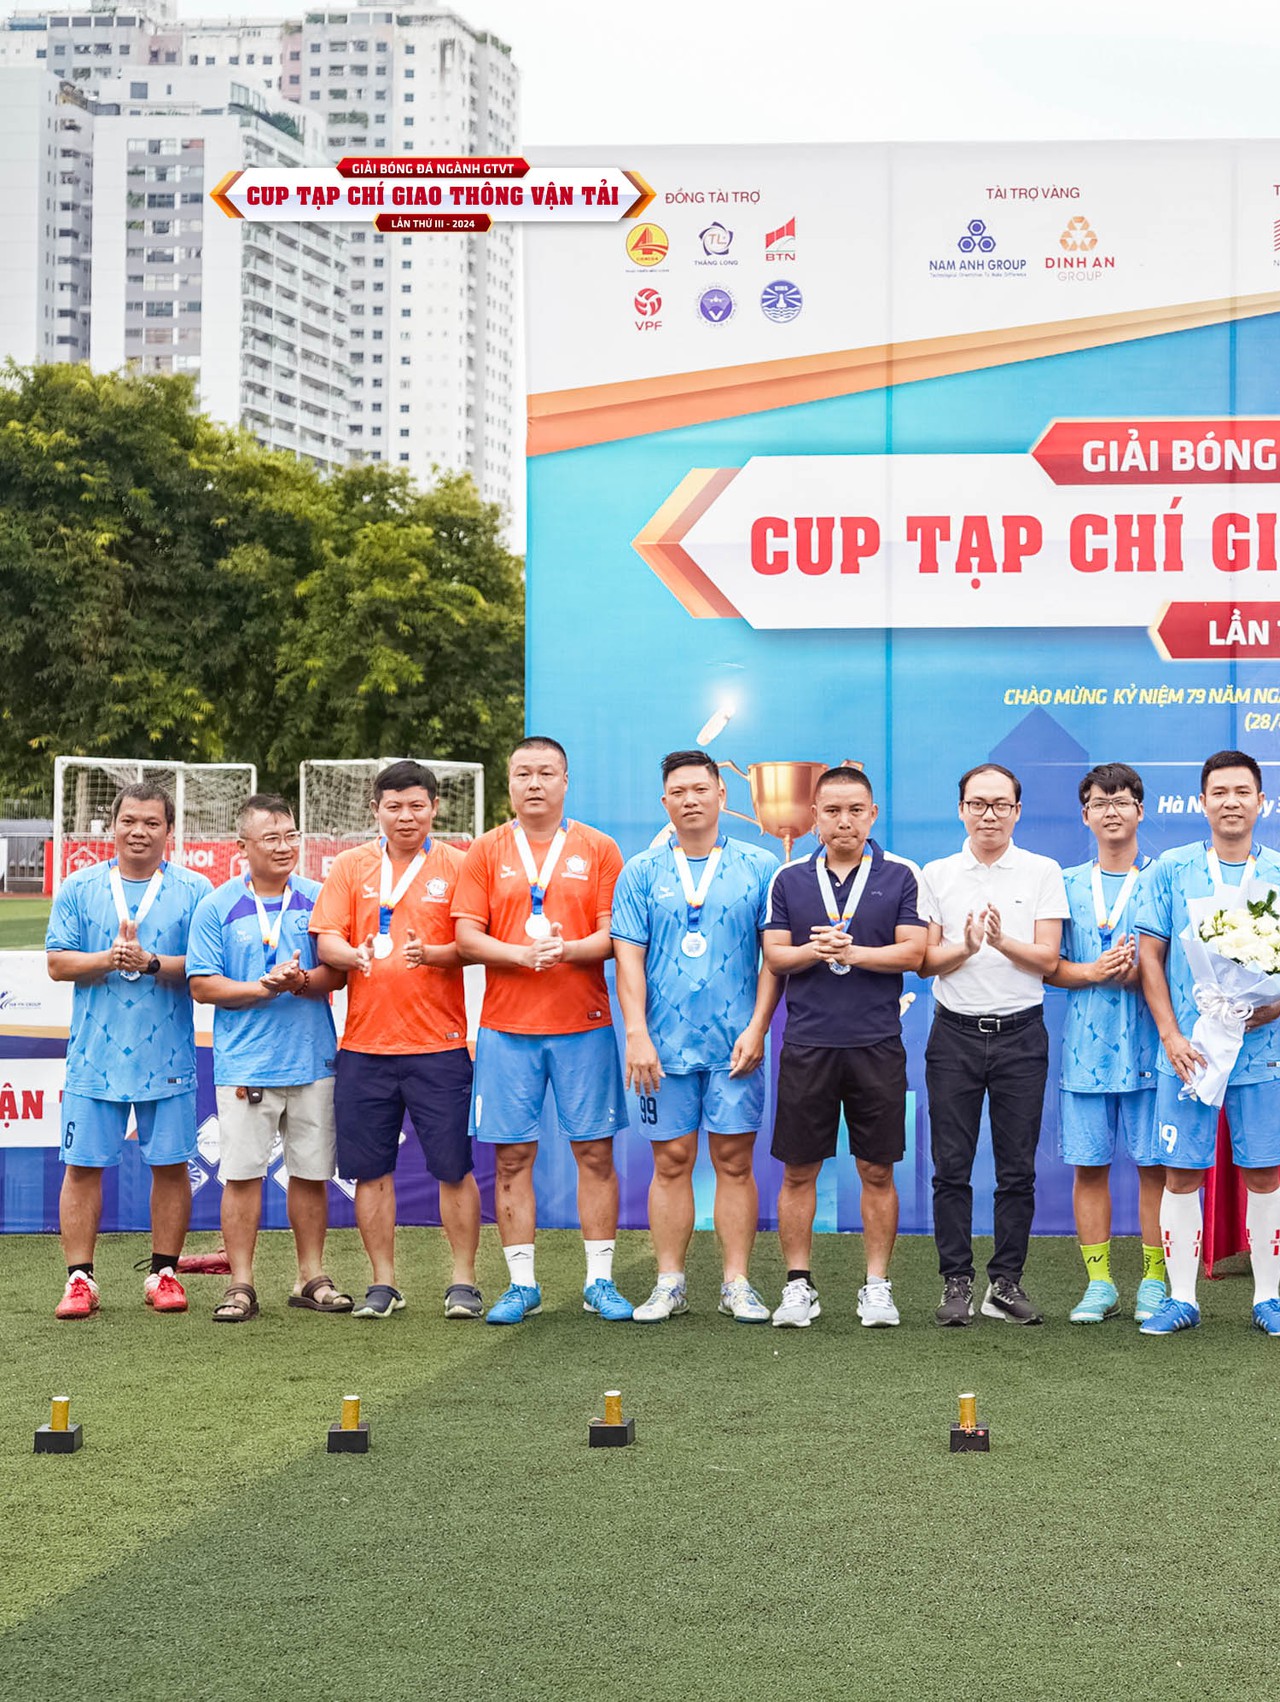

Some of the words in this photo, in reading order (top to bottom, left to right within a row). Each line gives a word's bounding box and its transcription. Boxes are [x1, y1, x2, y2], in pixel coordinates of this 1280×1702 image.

[708, 188, 729, 203] TÀI
[731, 190, 761, 205] TRỢ
[986, 184, 1007, 199] TÀI
[1010, 186, 1039, 201] TRỢ
[1042, 184, 1080, 199] VÀNG
[765, 253, 796, 261] BTN
[929, 259, 956, 270] NAM
[959, 259, 985, 270] ANH
[987, 259, 1027, 270] GROUP
[1045, 257, 1087, 268] DINH
[1092, 256, 1115, 268] AN
[1057, 271, 1102, 281] GROUP
[634, 320, 663, 331] VPF
[1082, 428, 1159, 473] GIẢI
[1171, 430, 1277, 472] BÓNG
[750, 515, 881, 576] CUP
[906, 514, 1043, 590] TẠP
[1069, 496, 1184, 573] CHÍ
[1208, 608, 1270, 646] LẦN
[1003, 687, 1053, 706] CHÀO
[1054, 686, 1107, 705] MỪNG
[1113, 683, 1138, 705] KỶ
[1138, 687, 1185, 708] NIỆM
[1187, 688, 1206, 704] 79
[1208, 685, 1251, 704] NĂM
[1158, 795, 1185, 814] Hà
[0, 1082, 44, 1128] ẬN
[640, 1095, 658, 1125] 99
[64, 1121, 76, 1150] 6
